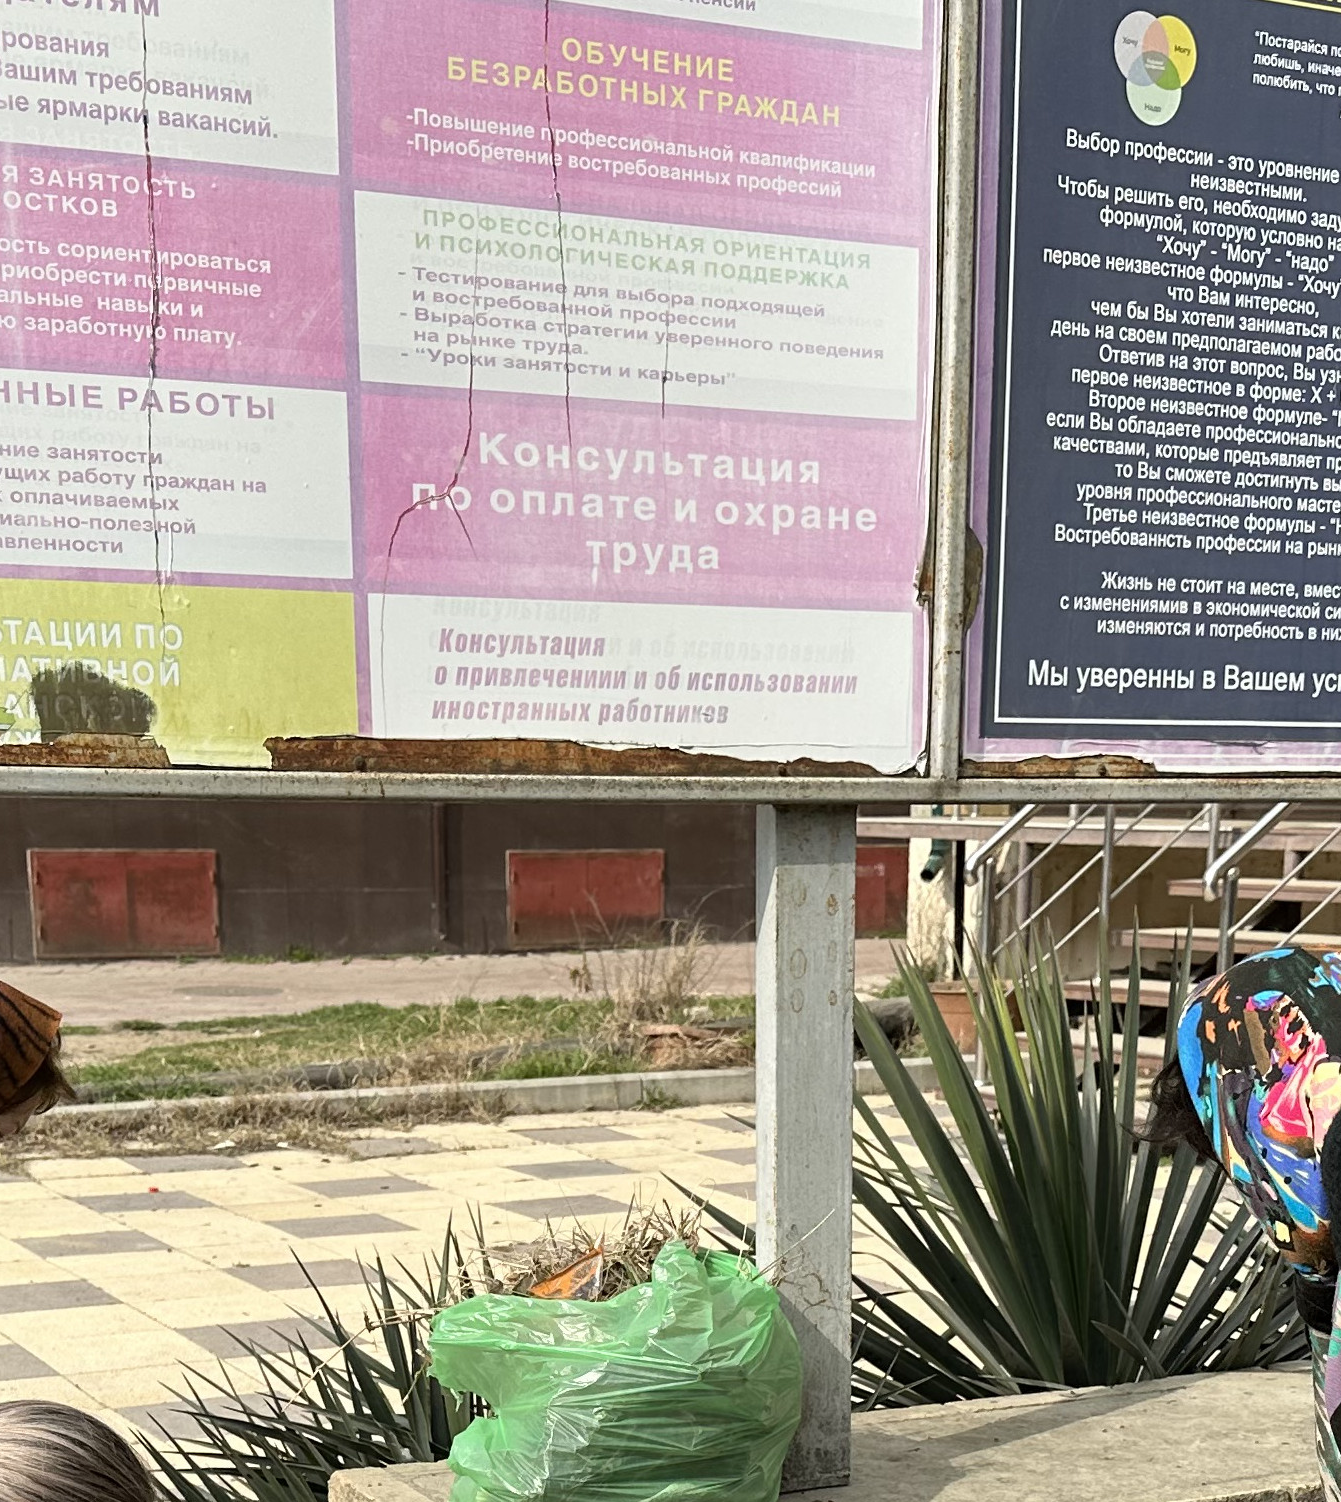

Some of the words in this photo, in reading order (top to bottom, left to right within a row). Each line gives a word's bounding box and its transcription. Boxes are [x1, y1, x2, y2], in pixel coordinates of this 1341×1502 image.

[562, 38, 733, 82] ОБУЧЕНИЕ
[1253, 53, 1304, 73] любишь,
[1308, 62, 1341, 76] иначе
[448, 56, 686, 109] БЕЗРАБОТНЫХ
[699, 89, 838, 127] ГРАЖДАН
[37, 96, 149, 136] ярмарки
[158, 110, 277, 138] вакансий.
[406, 107, 534, 138] -Повышение
[541, 127, 733, 162] профессиональной
[740, 151, 874, 178] квалификации
[29, 163, 195, 199] ЗАНЯТОСТЬ
[423, 206, 704, 253] ПРОФЕССИОНАЛЬНАЯ
[713, 239, 869, 269] ОРИЕНТАЦИЯ
[57, 243, 270, 274] сориентироваться
[415, 232, 429, 250] И
[440, 235, 694, 276] ПСИХОЛОГИЧЕСКАЯ
[704, 261, 848, 288] ПОДДЕРЖКА
[1168, 286, 1193, 302] что
[1199, 285, 1230, 306] Вам
[1235, 294, 1318, 318] интересно,
[119, 388, 276, 421] РАБОТЫ
[480, 432, 819, 486] Консультация
[410, 478, 471, 520] по
[490, 488, 656, 520] оплате
[675, 492, 706, 527] и
[715, 501, 876, 535] охране
[1076, 484, 1132, 501] уровня
[1137, 486, 1292, 510] профессионального
[585, 534, 718, 575] труда
[1101, 571, 1152, 590] Жизнь
[1157, 578, 1175, 591] не
[1181, 578, 1223, 593] стоит
[1227, 581, 1245, 594] на
[1250, 582, 1298, 599] месте,
[135, 622, 183, 650] ПО
[438, 628, 605, 659] Консультация
[435, 666, 447, 685] о
[634, 671, 647, 689] и
[655, 664, 681, 690] об
[687, 672, 857, 693] использовании
[1028, 659, 1068, 686] Мы
[1076, 667, 1194, 693] уверенны
[1202, 670, 1215, 689] в
[1224, 664, 1304, 691] Вашем
[432, 700, 590, 724] иностранных
